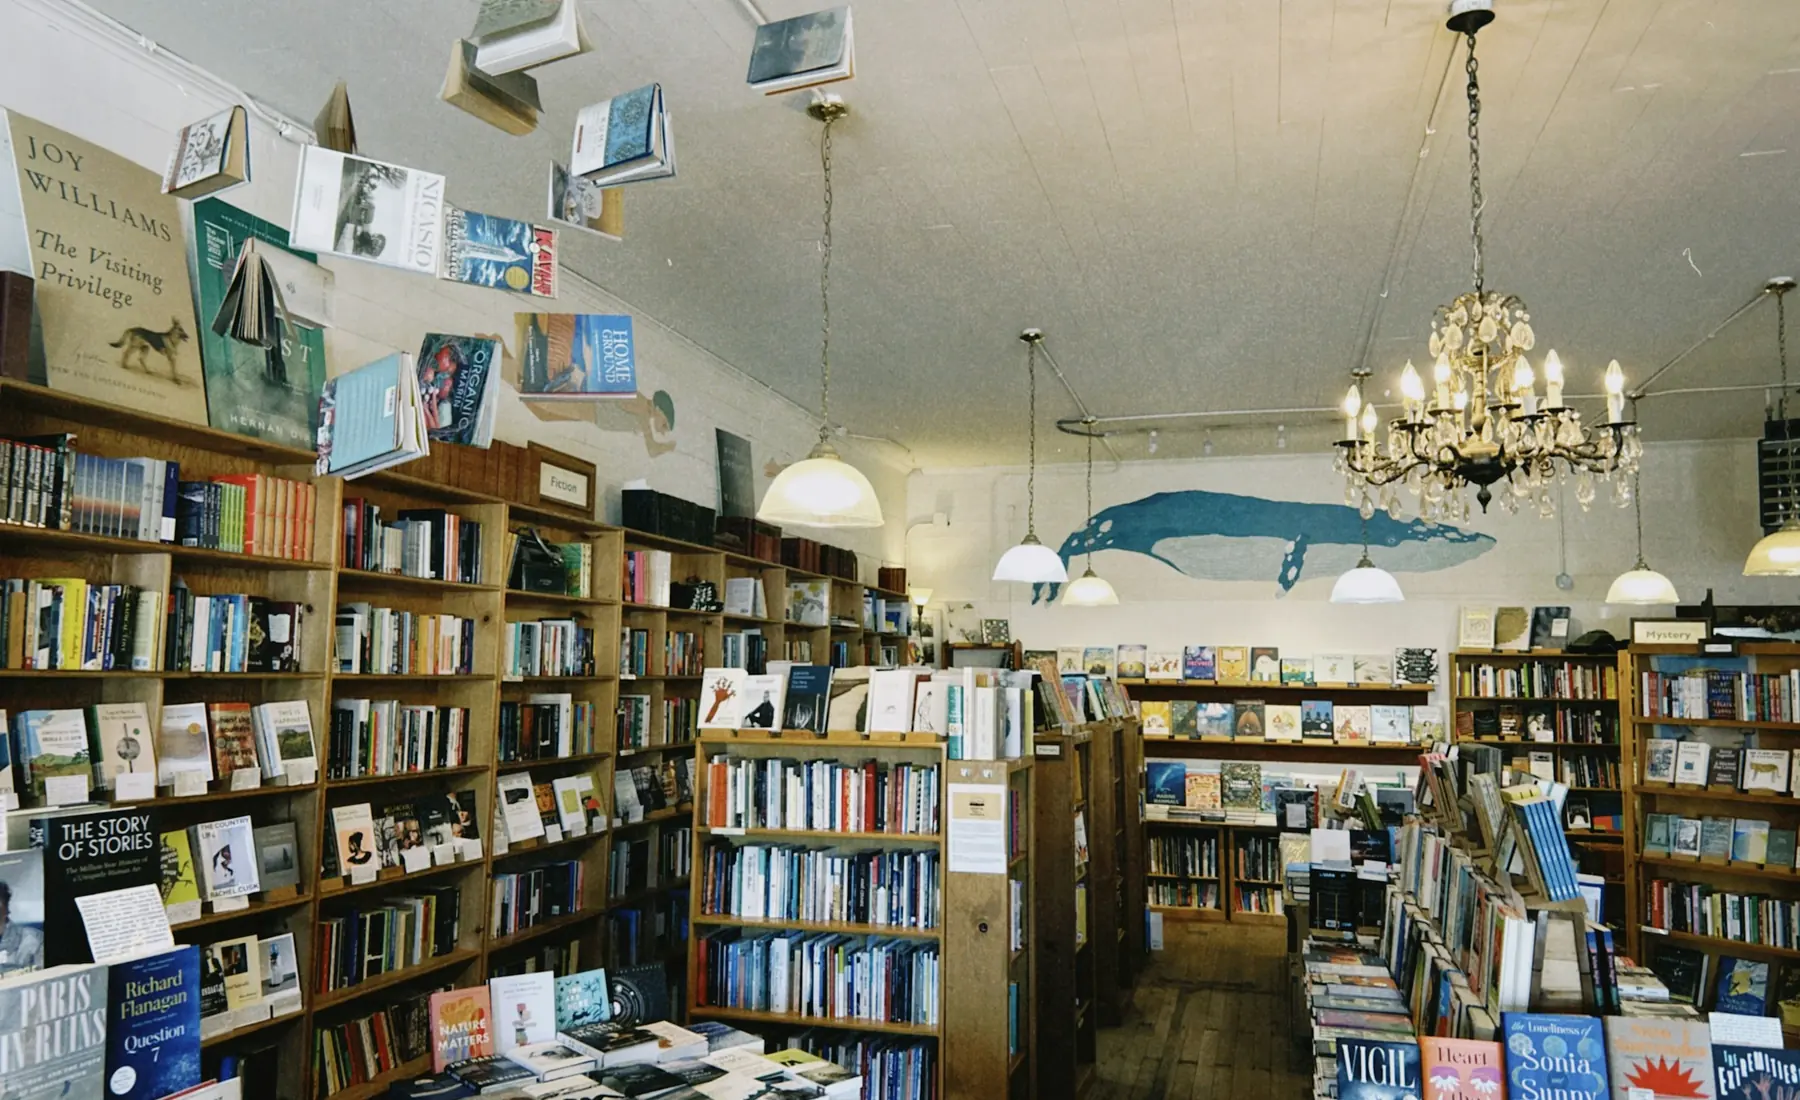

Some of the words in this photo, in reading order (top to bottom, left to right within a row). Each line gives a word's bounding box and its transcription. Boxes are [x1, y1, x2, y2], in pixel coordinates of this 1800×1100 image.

[28, 134, 85, 172] JOY
[24, 167, 173, 243] WILLIAMS
[415, 179, 440, 268] NICASIO
[35, 228, 78, 260] The
[89, 245, 164, 296] Visiting
[40, 260, 134, 310] Privilege
[604, 328, 615, 384] GROUND
[612, 329, 630, 383] HOME
[453, 368, 470, 409] MARIN
[457, 349, 487, 432] ORGANIC
[229, 413, 284, 437] HERNAN
[550, 475, 578, 494] Fiction
[1646, 630, 1692, 641] Mystery
[61, 821, 94, 841] THE
[97, 815, 150, 838] STORY
[201, 823, 213, 831] THE
[214, 818, 250, 829] COUNTRY
[58, 841, 84, 861] OF
[88, 832, 153, 857] STORIES
[210, 889, 237, 898] RACHEL
[238, 884, 259, 893] CUSK
[126, 969, 183, 1000] Richard
[21, 973, 92, 1029] PARIS
[120, 991, 187, 1020] Flanagan
[0, 1031, 25, 1074] IN
[35, 1007, 106, 1065] RUINS
[124, 1024, 186, 1054] Question
[439, 1018, 486, 1037] NATURE
[1511, 1021, 1525, 1031] the
[1527, 1021, 1580, 1035] Loneliness
[1580, 1025, 1594, 1041] of
[151, 1046, 162, 1063] 7
[437, 1033, 490, 1052] MATTERS
[1438, 1046, 1487, 1066] Heart
[1341, 1043, 1416, 1089] VIGIL
[1521, 1047, 1592, 1075] Sonia
[1723, 1049, 1738, 1067] THE
[1717, 1051, 1799, 1096] EXTREMITIES
[1521, 1078, 1597, 1100] Sunny
